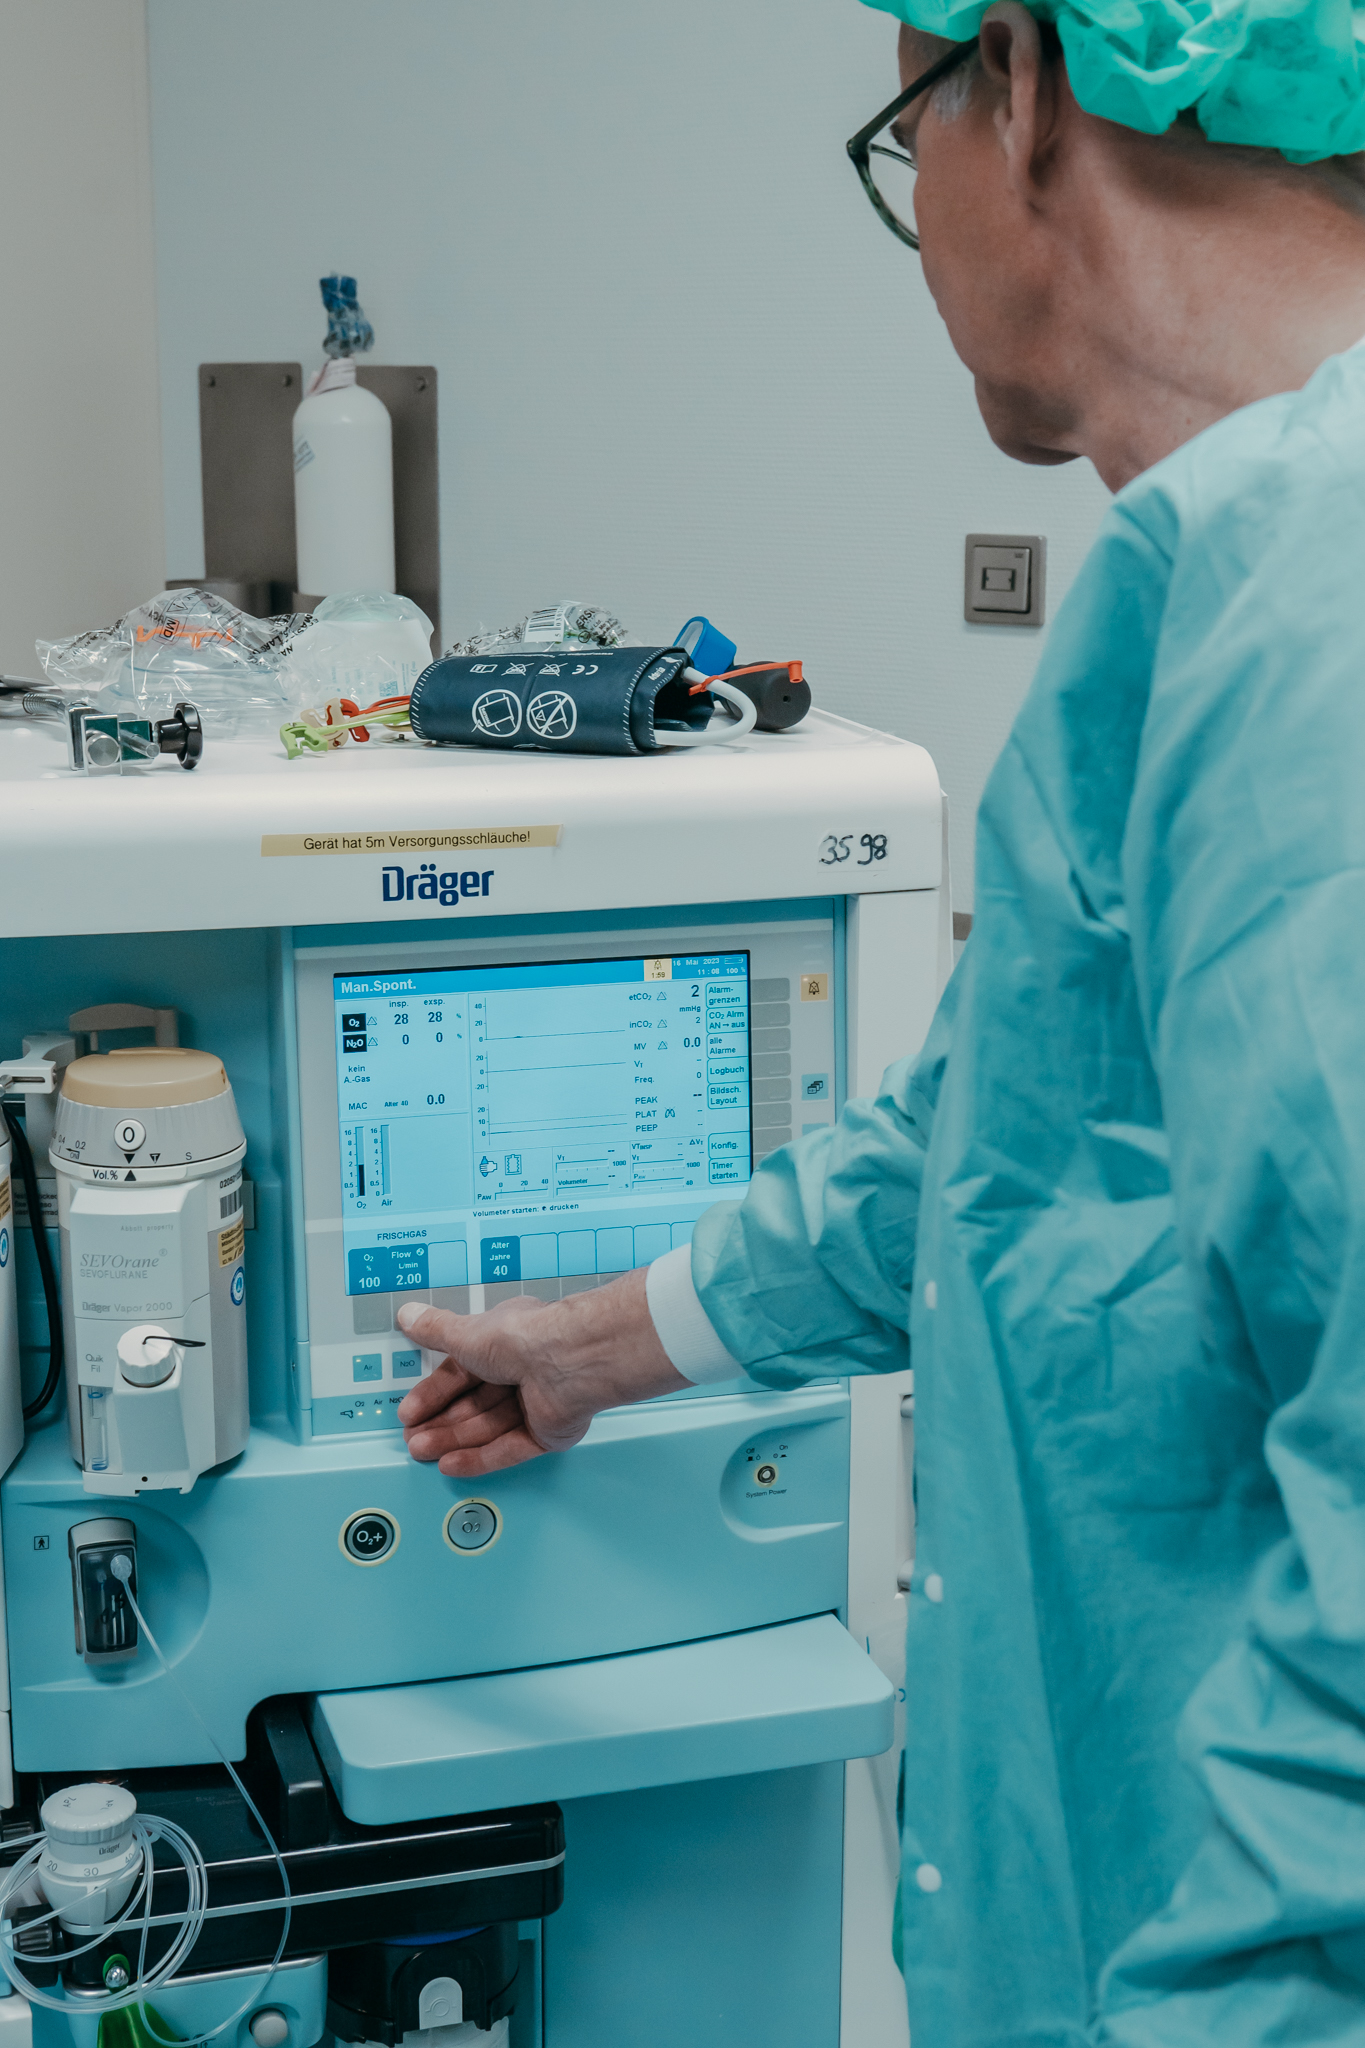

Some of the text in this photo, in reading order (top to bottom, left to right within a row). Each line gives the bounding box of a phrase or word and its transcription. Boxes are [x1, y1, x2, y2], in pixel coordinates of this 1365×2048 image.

[304, 831, 531, 850] Gerät hat 5m Versorgungsschläuche!
[382, 863, 495, 906] Dräger
[341, 979, 417, 994] Man.Spont.
[691, 984, 700, 997] 2
[389, 999, 445, 1009] insp. exsp.
[708, 997, 741, 1005] grenzen
[679, 1005, 701, 1013] mmHg
[394, 1013, 409, 1025] 28
[428, 1011, 443, 1024] 28
[402, 1034, 410, 1045] 0
[436, 1032, 443, 1043] 0
[634, 1037, 701, 1050] MV 0.0
[710, 1046, 736, 1054] Alarme
[348, 1064, 366, 1073] kein
[710, 1065, 745, 1075] Logbuch
[634, 1071, 702, 1085] Freq. 0
[710, 1086, 742, 1095] Bildsch.
[348, 1102, 368, 1111] MAC
[427, 1094, 445, 1105] 0.0
[635, 1096, 658, 1105] PEAK
[710, 1096, 738, 1106] Layout
[635, 1109, 657, 1118] PLAT
[635, 1123, 658, 1132] PEEP
[75, 1140, 86, 1150] 0.2
[711, 1141, 739, 1151] Konfig.
[711, 1161, 734, 1169] Timer
[93, 1169, 118, 1180] Vol.%
[711, 1171, 739, 1179] starten
[473, 1209, 510, 1217] Volumeter
[549, 1203, 579, 1211] drucken
[377, 1230, 427, 1241] FRISCHGAS
[491, 1241, 510, 1250] Alter
[391, 1251, 412, 1259] Flow
[489, 1253, 511, 1261] Jahre
[398, 1261, 419, 1269] L/min
[80, 1269, 148, 1279] SEVOFLURANE
[493, 1265, 508, 1276] 40
[358, 1276, 381, 1289] 100
[396, 1273, 422, 1286] 2.00
[82, 1301, 173, 1314] Dräger Vapor 2000
[746, 1490, 767, 1498] System
[98, 1843, 121, 1855] Dräger
[47, 1860, 58, 1872] 20
[84, 1867, 99, 1877] 30
